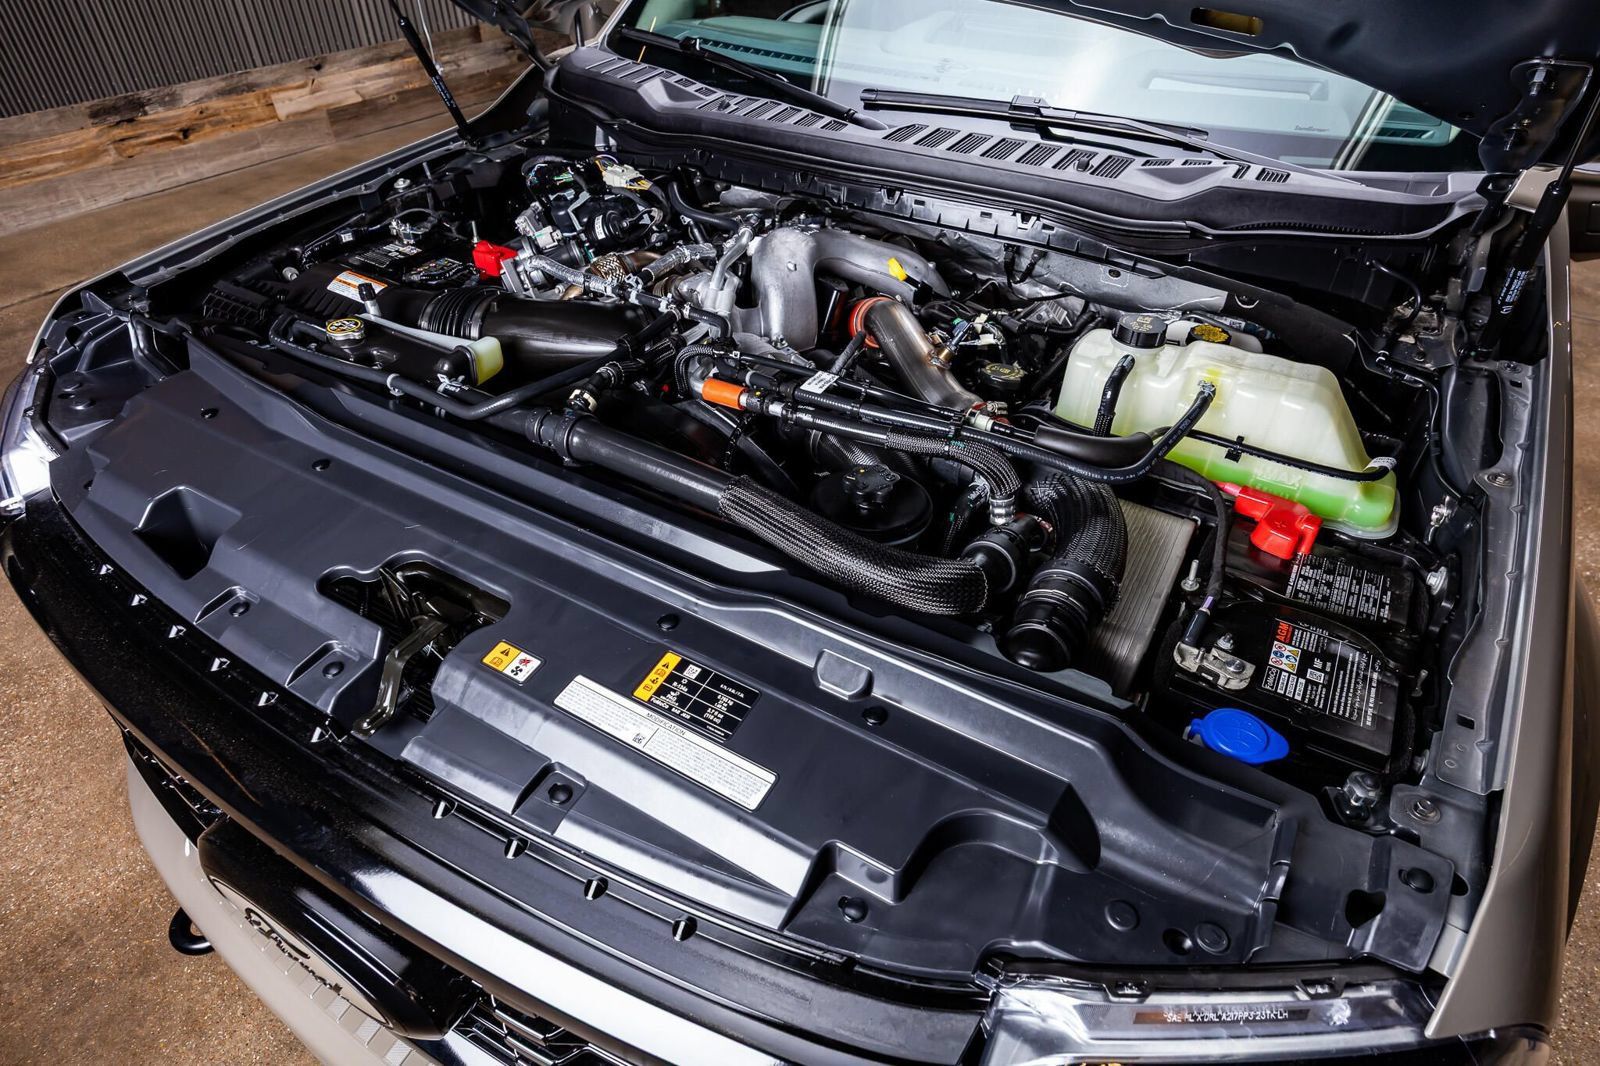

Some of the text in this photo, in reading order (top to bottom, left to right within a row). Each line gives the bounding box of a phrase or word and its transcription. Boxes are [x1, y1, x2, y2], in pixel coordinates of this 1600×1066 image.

[1277, 622, 1289, 642] AGM
[1265, 667, 1278, 690] FoMoCo
[646, 712, 686, 736] MODIFICATION
[1166, 1014, 1182, 1023] SAE
[1204, 1013, 1219, 1022] DRL
